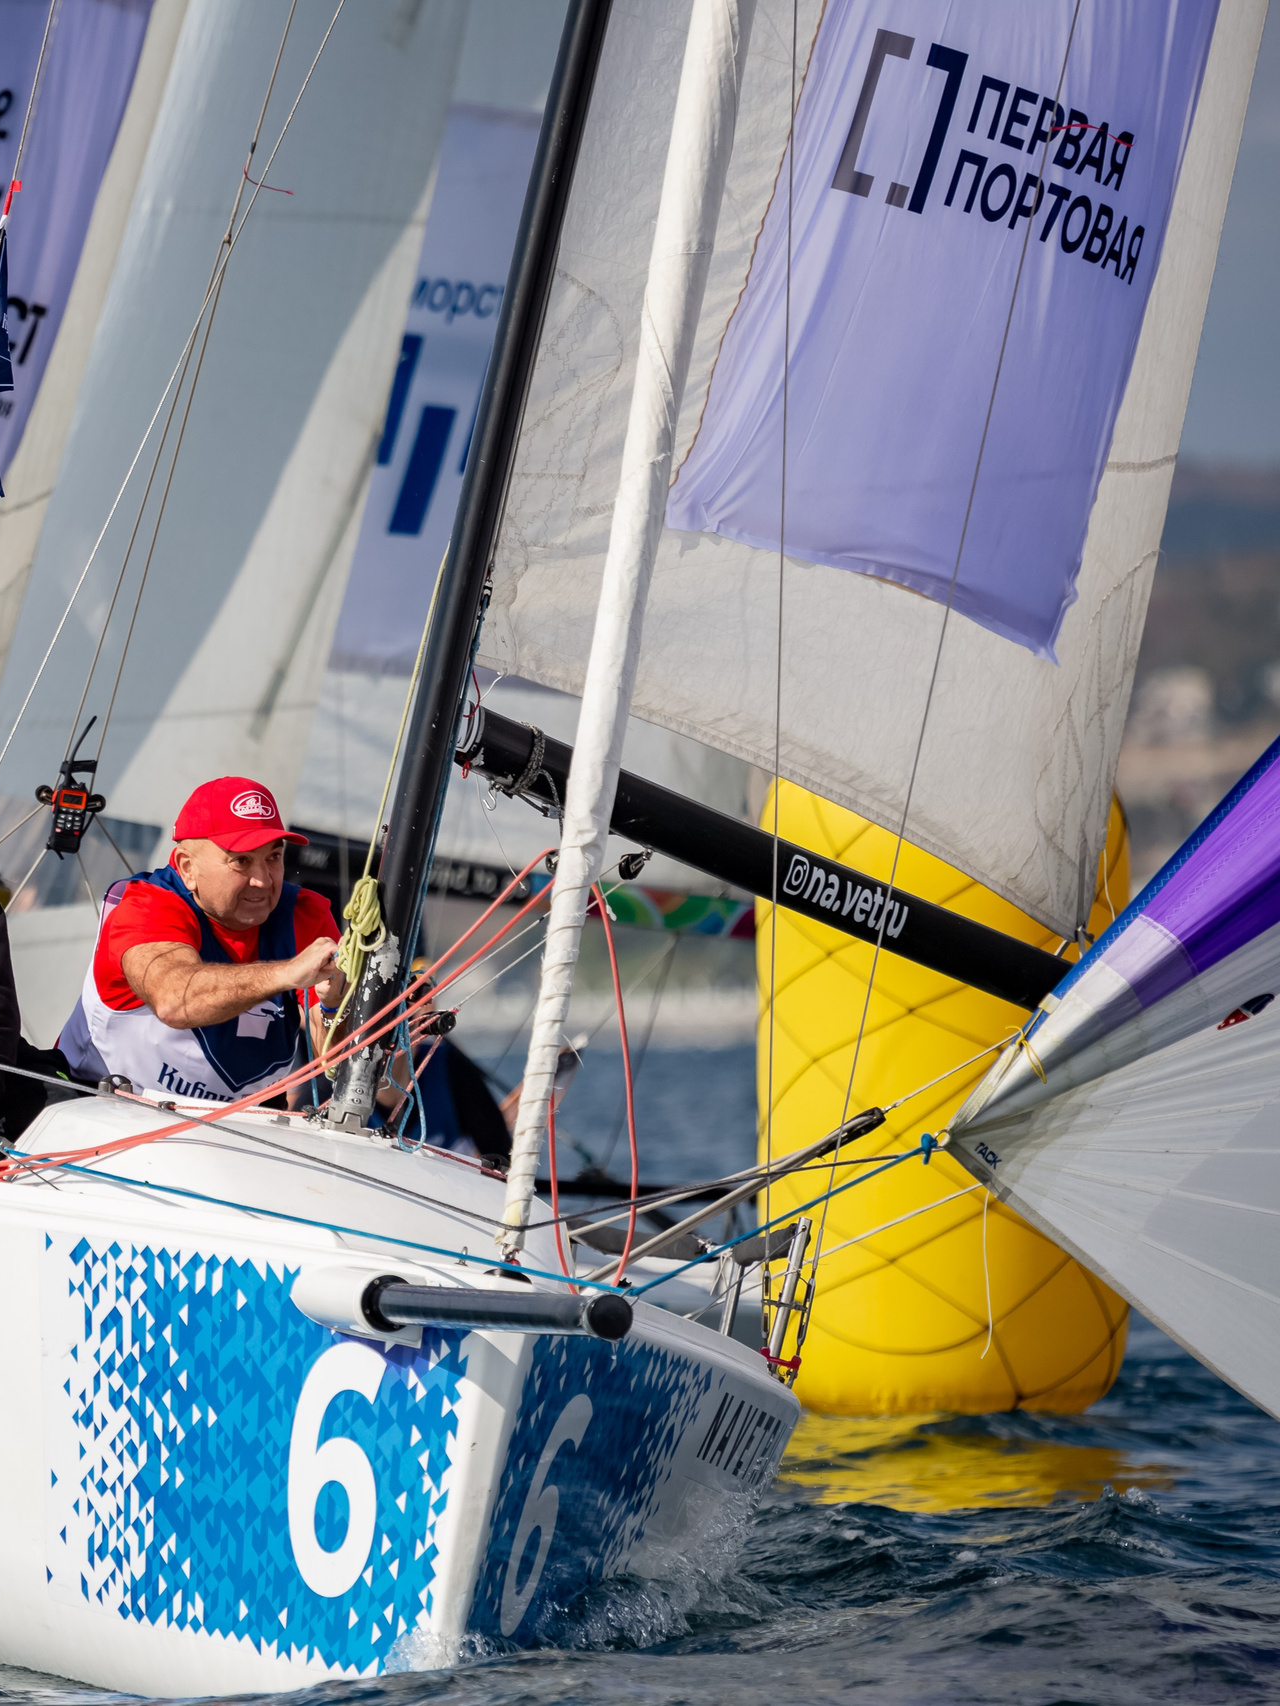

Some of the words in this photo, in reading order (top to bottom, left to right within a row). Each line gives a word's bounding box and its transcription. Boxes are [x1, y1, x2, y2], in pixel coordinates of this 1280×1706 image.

[966, 74, 1135, 192] ПЕРВАЯ
[943, 148, 1146, 286] ПОРТОВАЯ
[802, 865, 909, 939] na.vetru
[974, 1141, 1003, 1170] TACK
[288, 1341, 388, 1599] 6
[501, 1392, 594, 1637] 6
